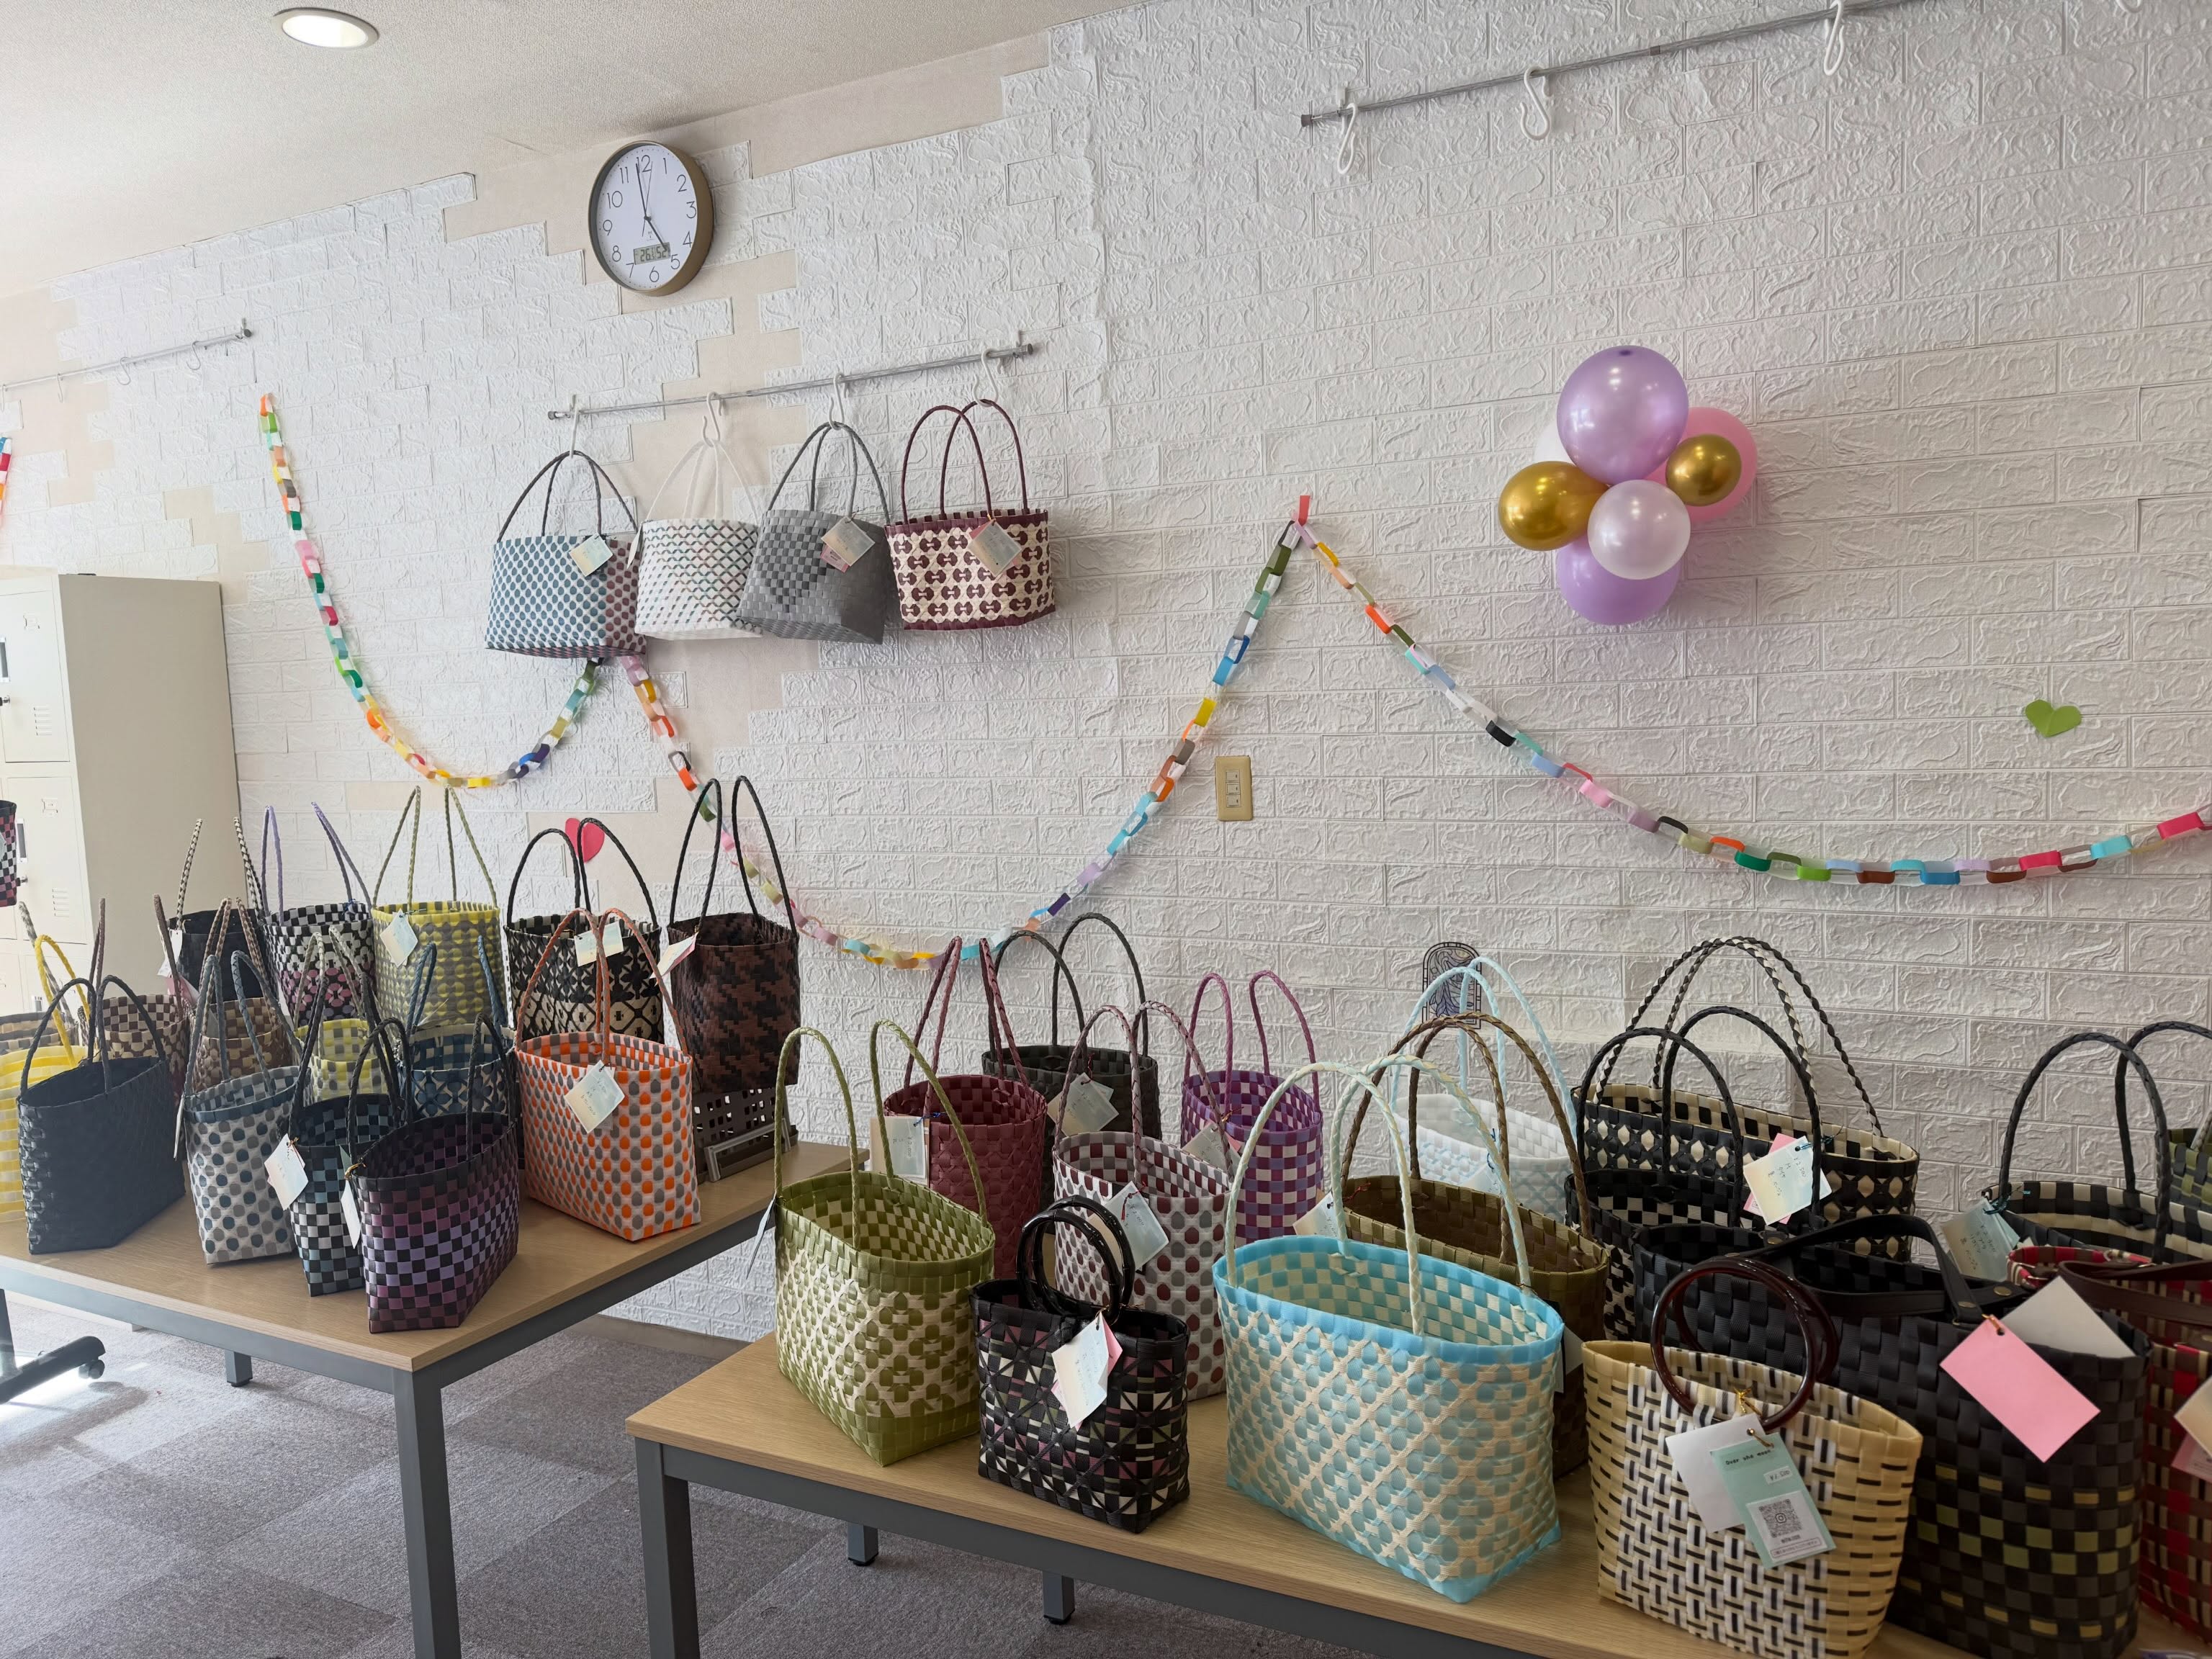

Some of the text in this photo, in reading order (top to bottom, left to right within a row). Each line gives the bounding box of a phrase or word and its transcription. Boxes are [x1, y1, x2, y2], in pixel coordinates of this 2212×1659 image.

[637, 155, 651, 173] 12
[663, 158, 667, 174] 1
[620, 166, 629, 184] 11
[677, 174, 687, 192] 2
[607, 190, 623, 209] 10
[686, 201, 697, 219] 3
[603, 220, 613, 235] 9
[683, 230, 692, 248] 4
[612, 245, 621, 262] 8
[670, 253, 680, 270] 5
[626, 263, 634, 278] 7
[649, 266, 659, 282] 6
